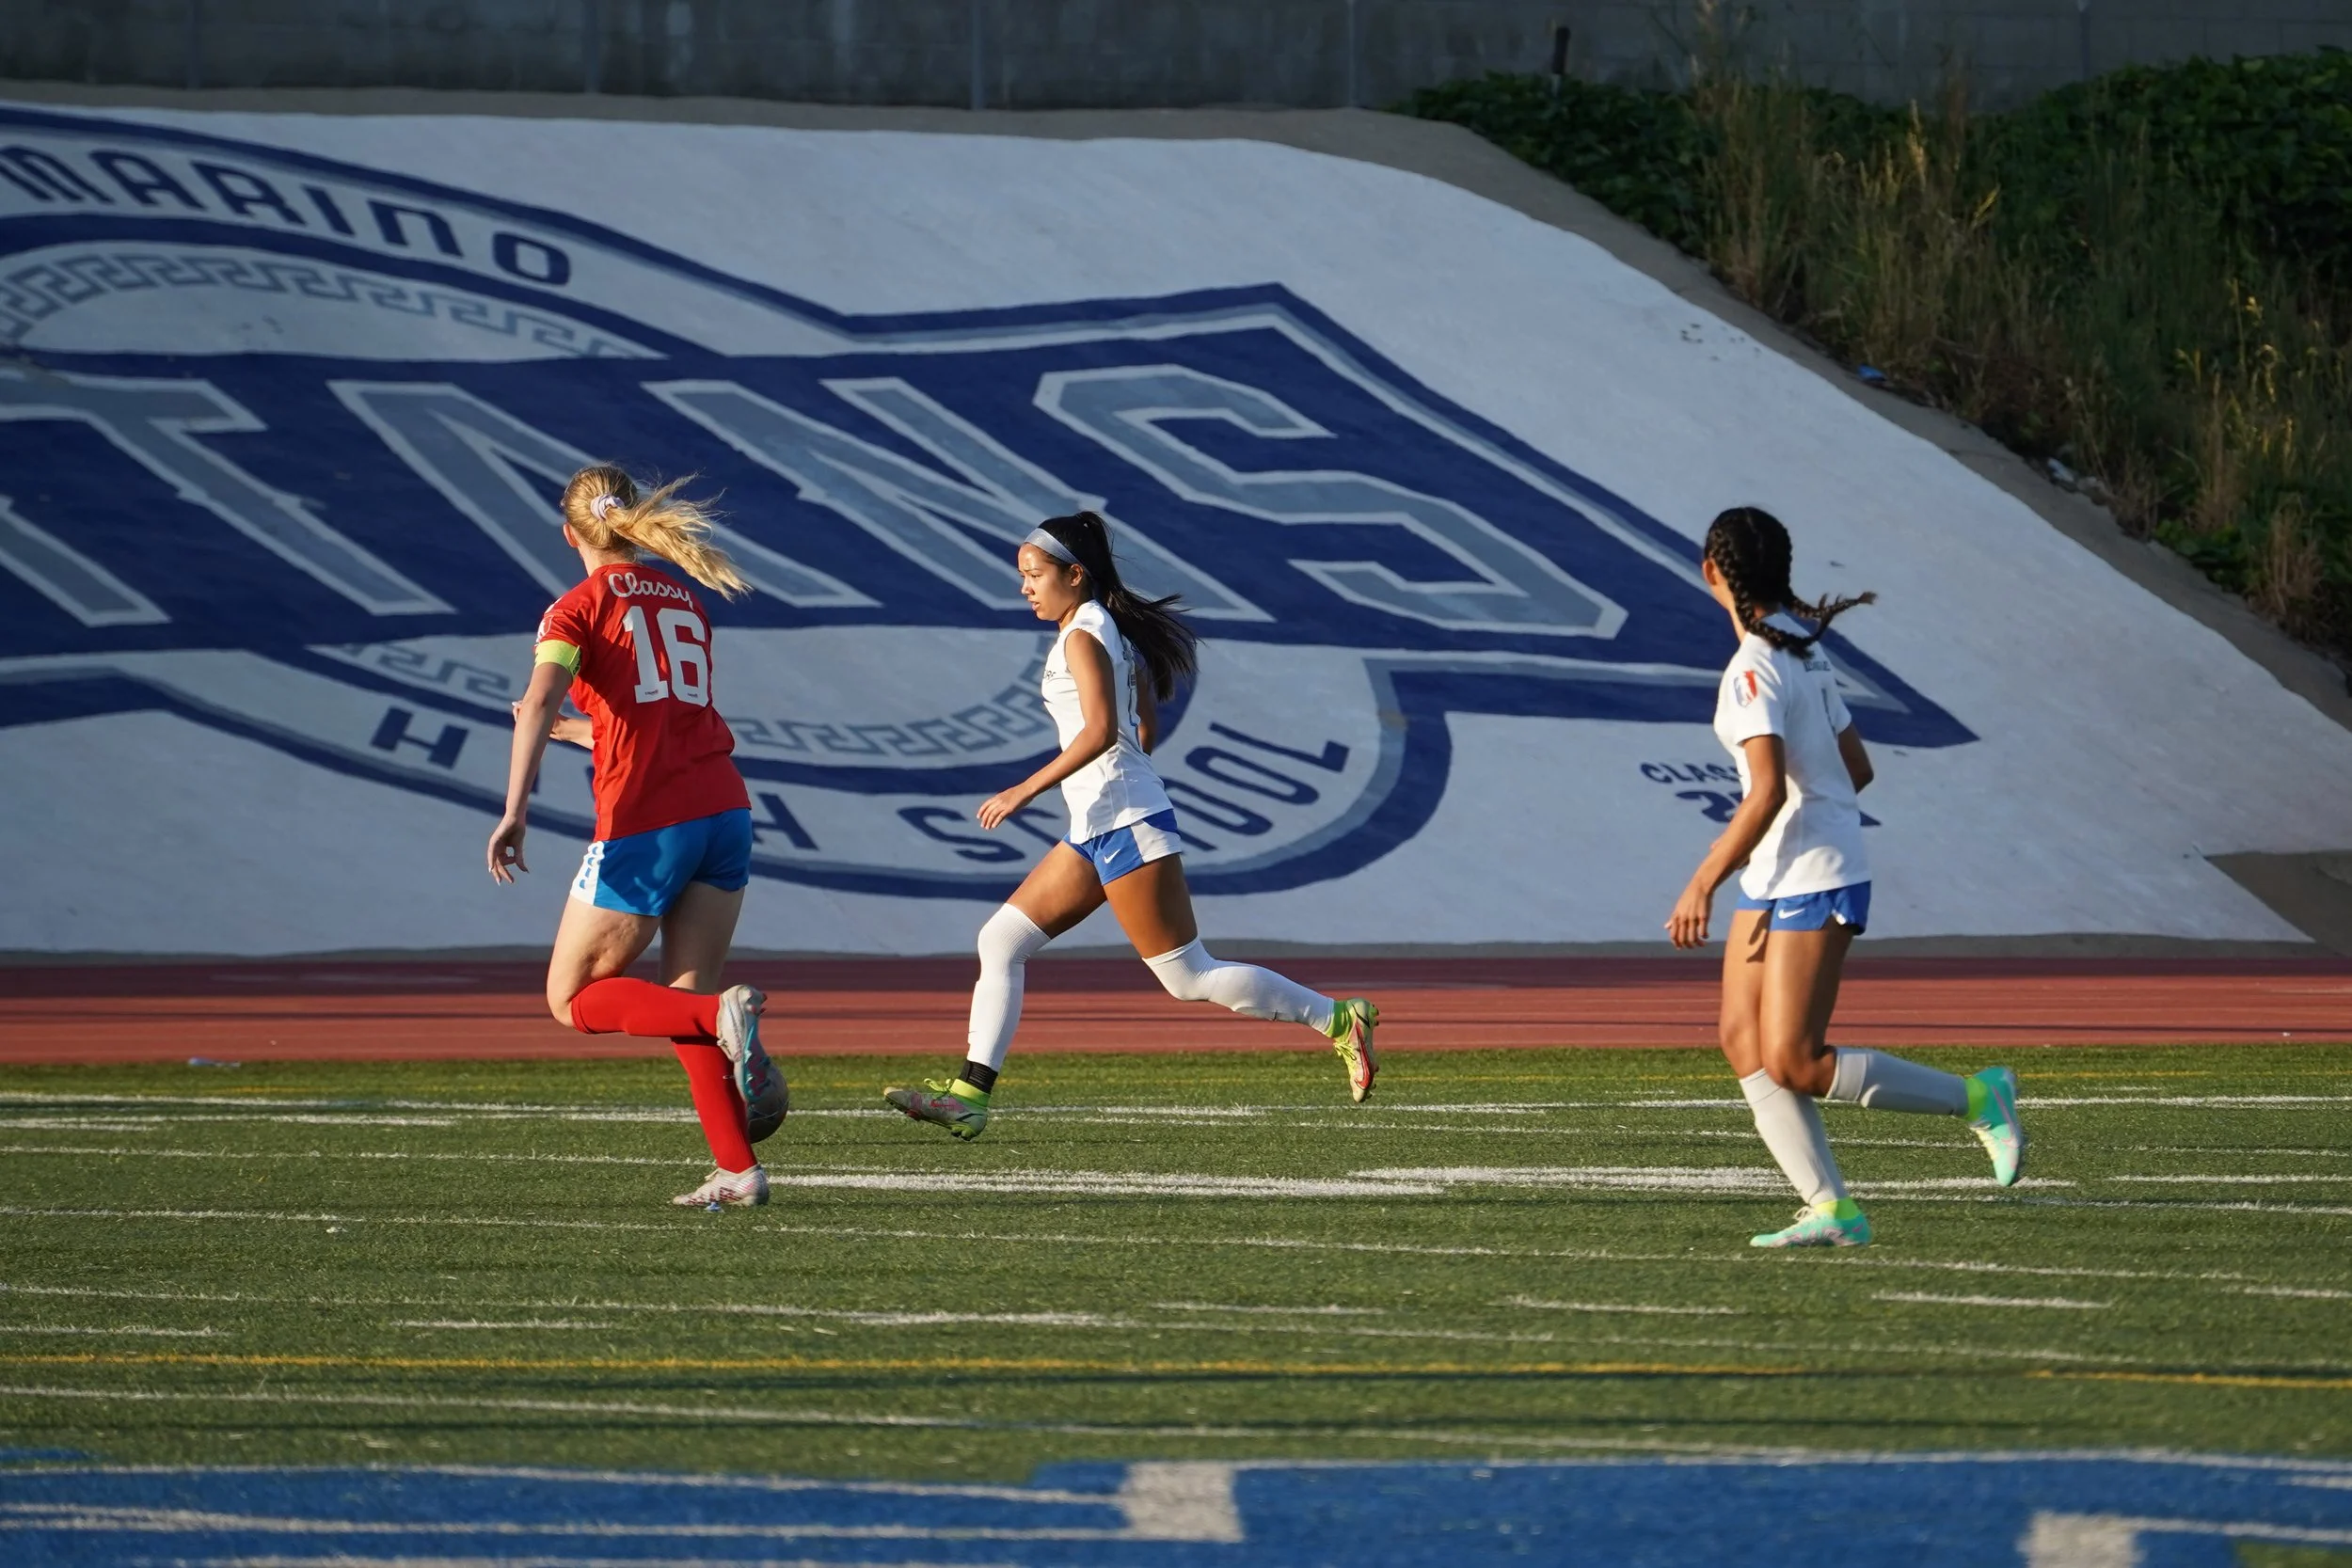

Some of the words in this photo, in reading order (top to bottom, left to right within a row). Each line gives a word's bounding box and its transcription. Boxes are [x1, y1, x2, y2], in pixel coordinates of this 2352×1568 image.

[608, 572, 694, 610] Classy
[622, 606, 709, 707] 16
[1640, 763, 1743, 784] CLAS
